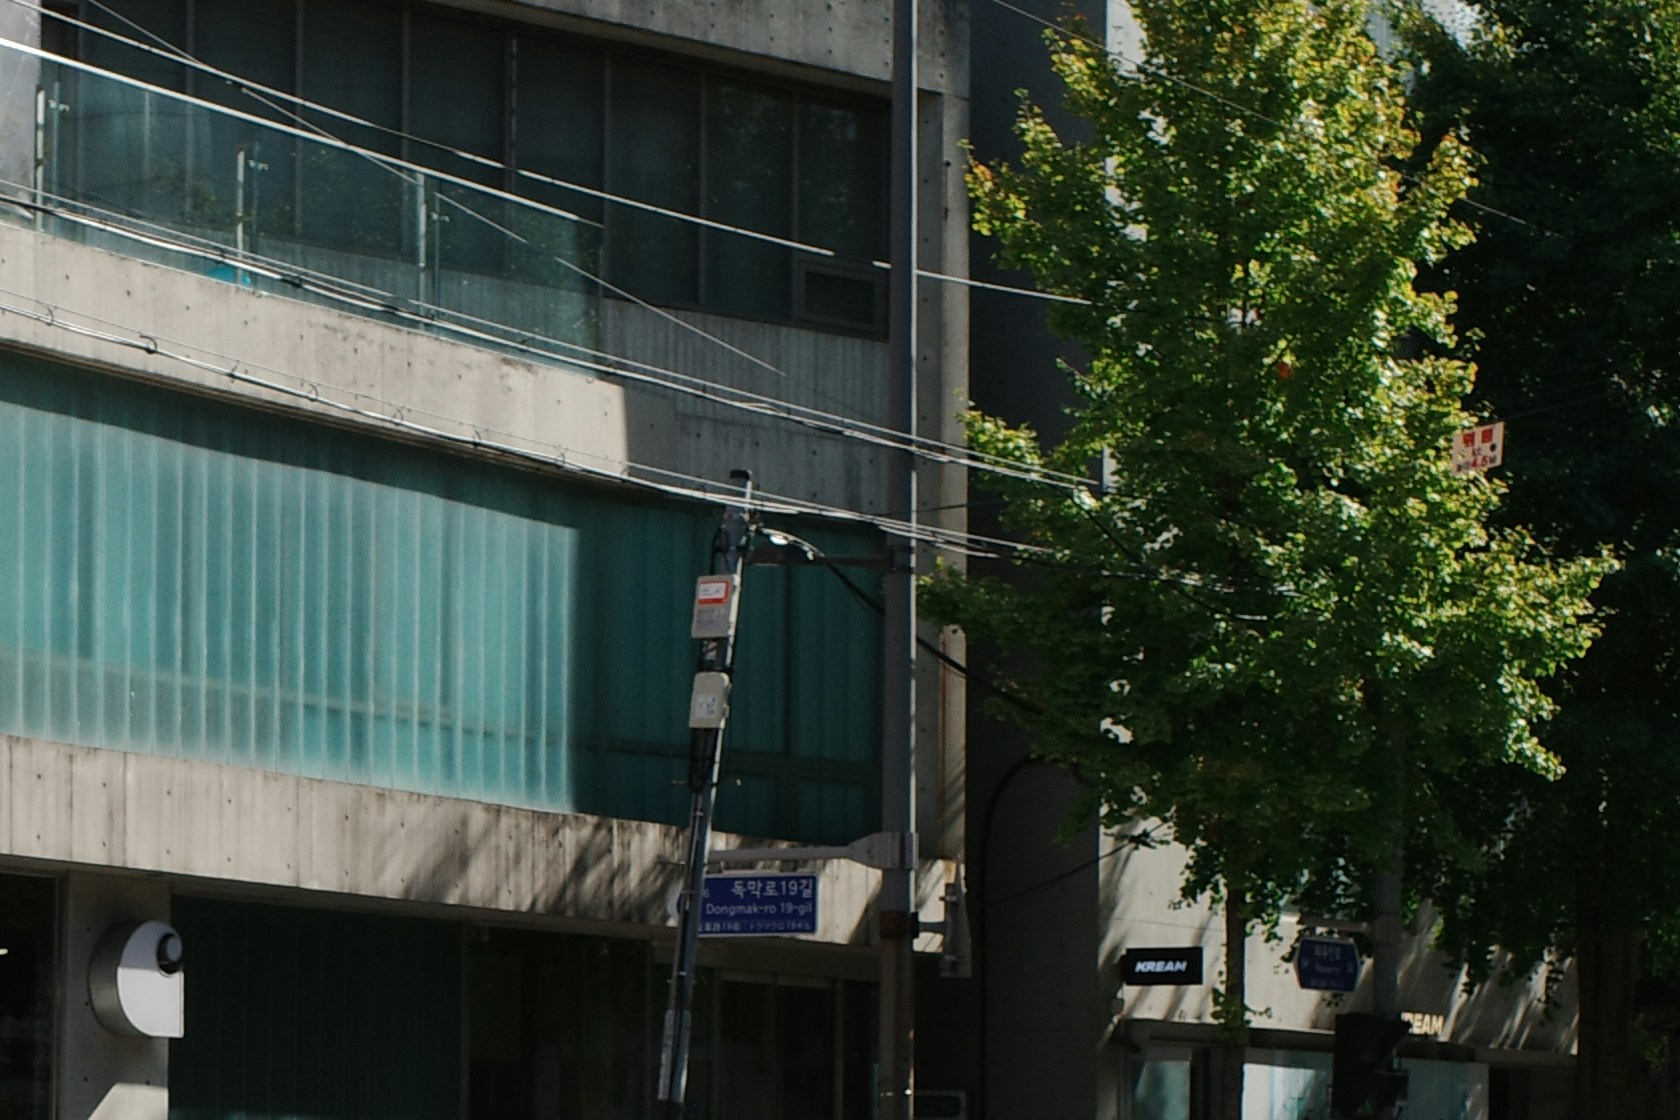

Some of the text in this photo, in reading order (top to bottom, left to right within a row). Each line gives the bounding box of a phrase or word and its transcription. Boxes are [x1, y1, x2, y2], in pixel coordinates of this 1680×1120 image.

[731, 879, 813, 899] 독막로19길
[706, 901, 813, 918] Dongmak-ro 19-gil
[1134, 960, 1188, 973] KREAM
